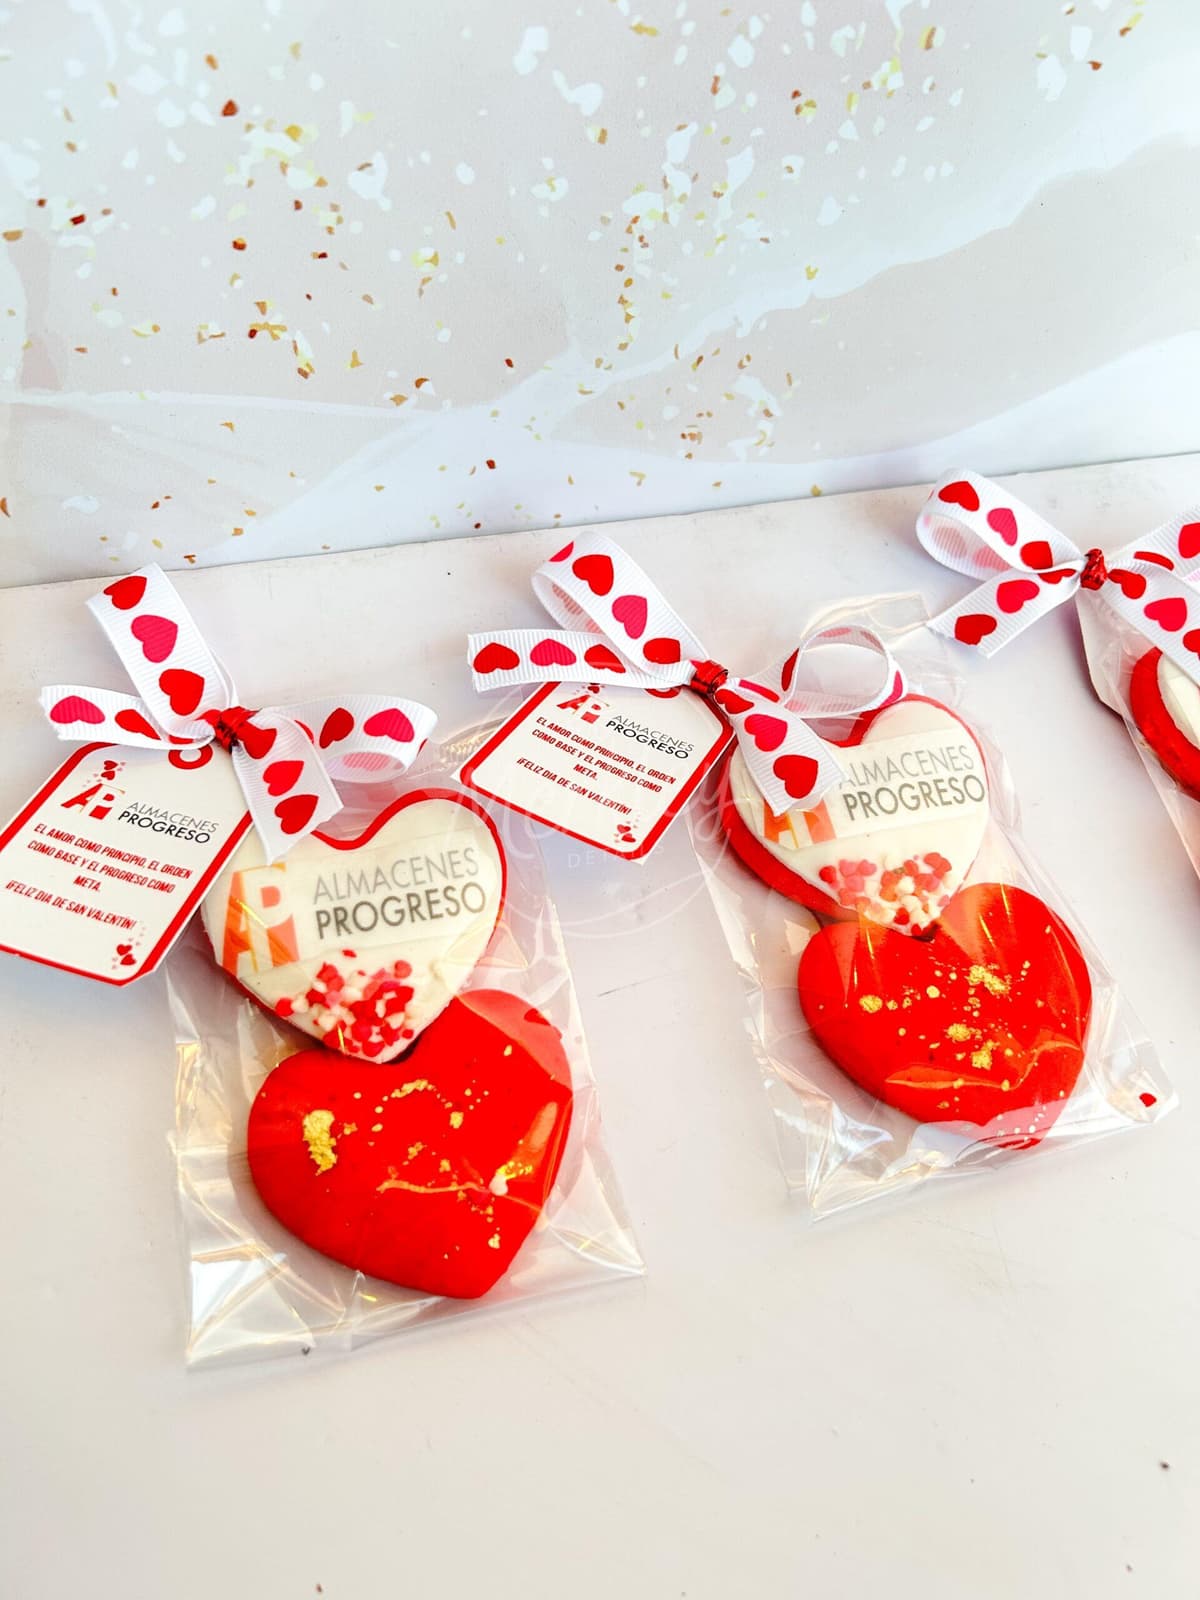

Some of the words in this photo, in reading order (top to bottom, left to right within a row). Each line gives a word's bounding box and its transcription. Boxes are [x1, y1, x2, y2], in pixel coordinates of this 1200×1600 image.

[536, 716, 548, 728] EL
[546, 722, 572, 739] AMOR
[571, 734, 596, 750] COMO
[635, 763, 648, 775] EL
[647, 768, 677, 785] ORDEN
[605, 720, 689, 760] PROGRESO
[612, 715, 695, 753] ALMACENES
[516, 757, 545, 774] ¡FELIZ
[557, 775, 572, 788] DE
[569, 782, 589, 797] SAN
[532, 728, 557, 745] COMO
[554, 740, 578, 756] BASE
[577, 750, 586, 760] Y
[583, 754, 596, 766] EL
[593, 759, 639, 784] PROGRESO
[637, 778, 663, 794] COMO
[573, 763, 598, 781] META.
[839, 745, 975, 790] LMACENES
[126, 801, 220, 833] ALMACENES
[842, 774, 985, 821] PROGRESO
[118, 811, 211, 844] PROGRESO
[27, 840, 55, 857] COMO
[54, 850, 80, 865] BASE
[79, 858, 88, 868] Y
[87, 860, 100, 872] EL
[99, 864, 148, 887] PROGRESO
[147, 877, 176, 894] COMO
[34, 823, 46, 835] EL
[46, 828, 76, 845] AMOR
[74, 837, 102, 853] COMO
[101, 846, 147, 869] PRINCIPIO,
[147, 860, 160, 871] EL
[160, 863, 193, 879] ORDEN
[313, 847, 480, 905] ALMACENES
[51, 895, 68, 909] DE
[66, 900, 88, 914] SAN
[315, 881, 486, 940] PROGRESO
